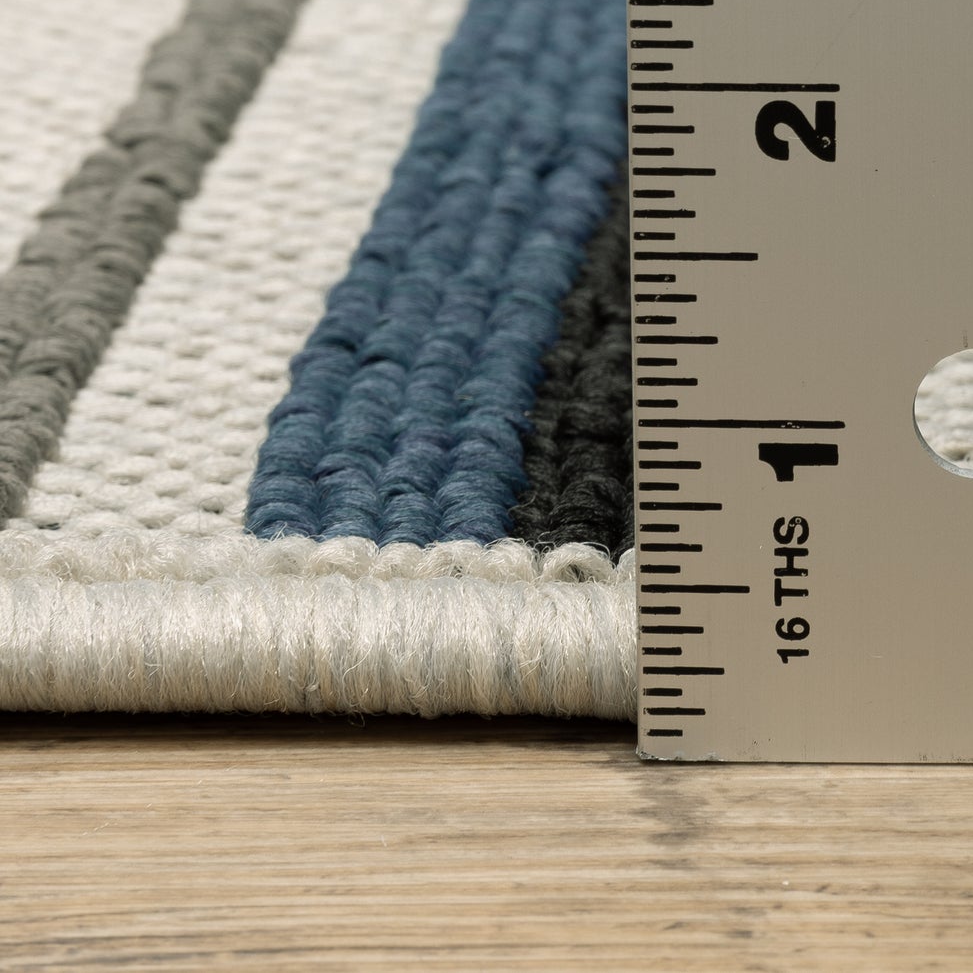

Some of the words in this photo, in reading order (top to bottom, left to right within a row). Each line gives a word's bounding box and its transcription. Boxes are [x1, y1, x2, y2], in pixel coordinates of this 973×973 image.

[755, 100, 836, 162] 2
[758, 443, 838, 482] 1
[773, 516, 810, 607] THS
[776, 617, 810, 664] 16
